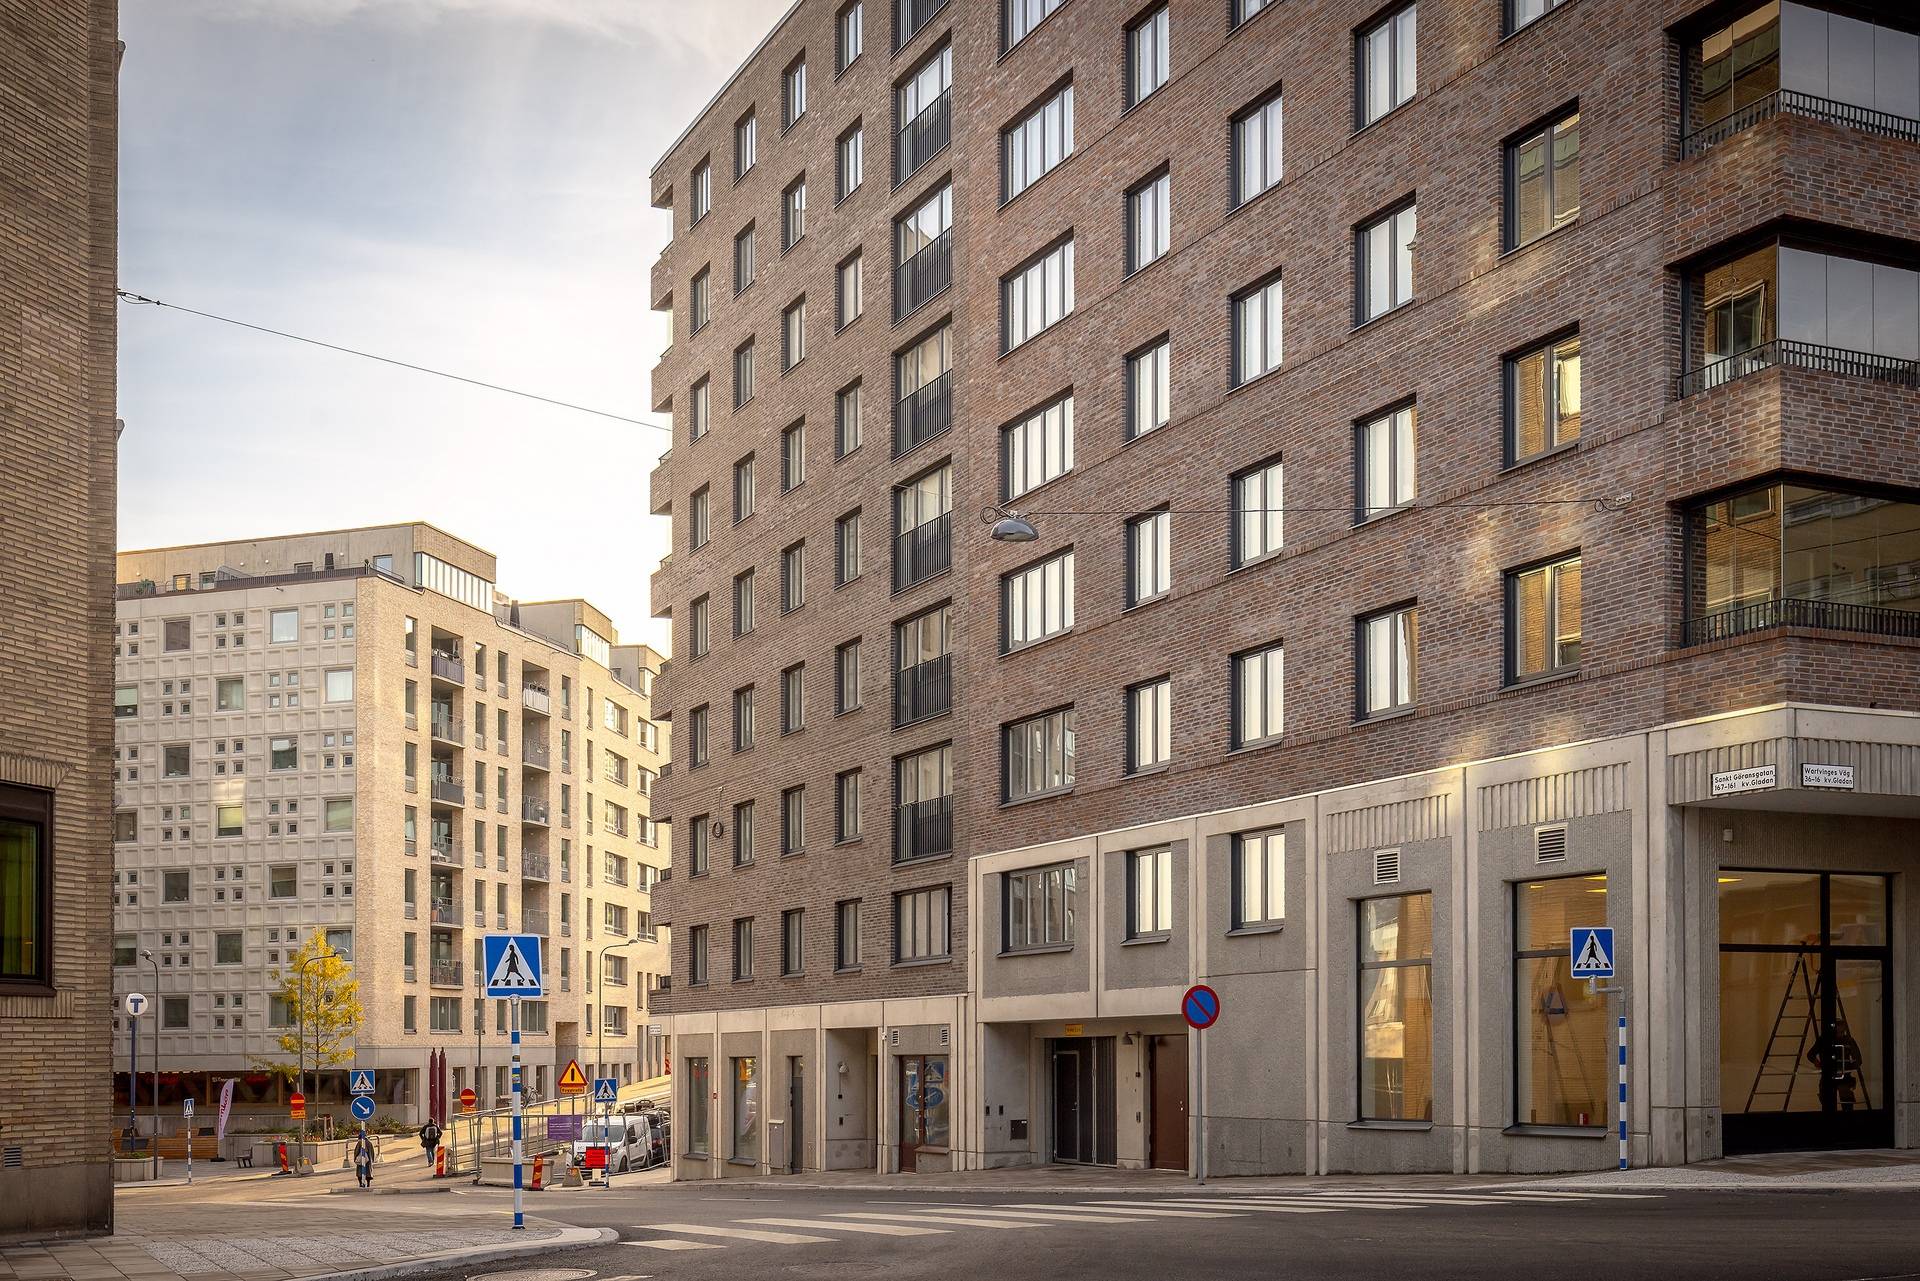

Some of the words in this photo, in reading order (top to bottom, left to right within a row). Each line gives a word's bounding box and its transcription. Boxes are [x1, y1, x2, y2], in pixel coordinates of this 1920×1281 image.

[1714, 776, 1732, 784] Sankt
[1733, 770, 1774, 780] Göransgatan
[130, 998, 143, 1013] T
